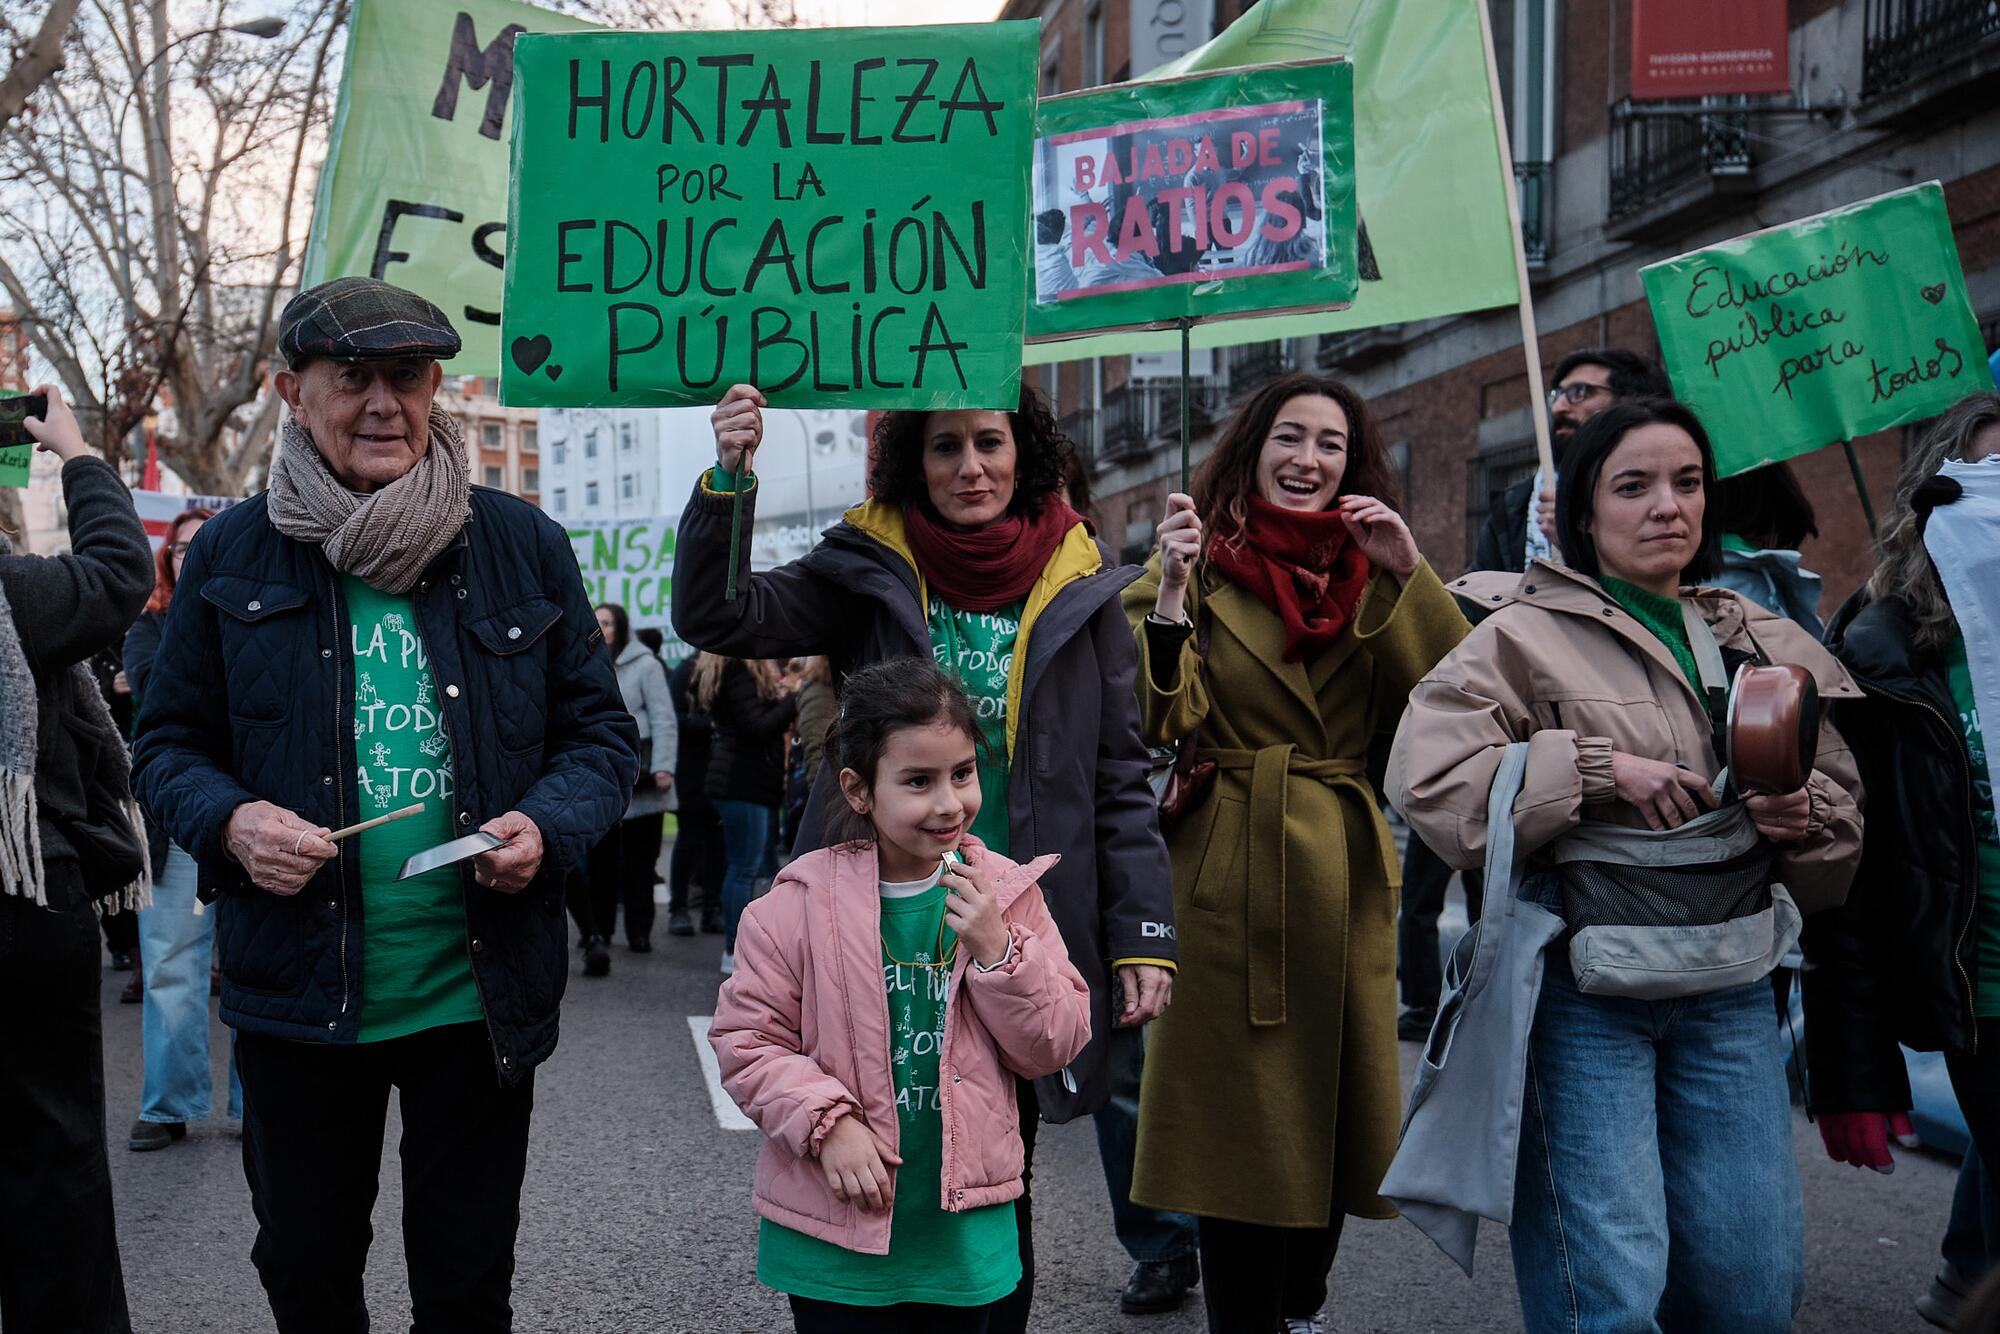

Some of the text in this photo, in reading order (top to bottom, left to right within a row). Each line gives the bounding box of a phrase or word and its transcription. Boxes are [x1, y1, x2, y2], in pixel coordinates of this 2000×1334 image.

[567, 53, 1005, 148] HORTALEZA
[657, 162, 826, 204] POR LA
[1074, 128, 1282, 192] BAJADA DE
[1070, 176, 1302, 268] RATIOS
[1686, 240, 1889, 318] Educación
[1704, 303, 1844, 380] pública
[1773, 340, 1864, 400] para
[1866, 337, 1963, 403] todos
